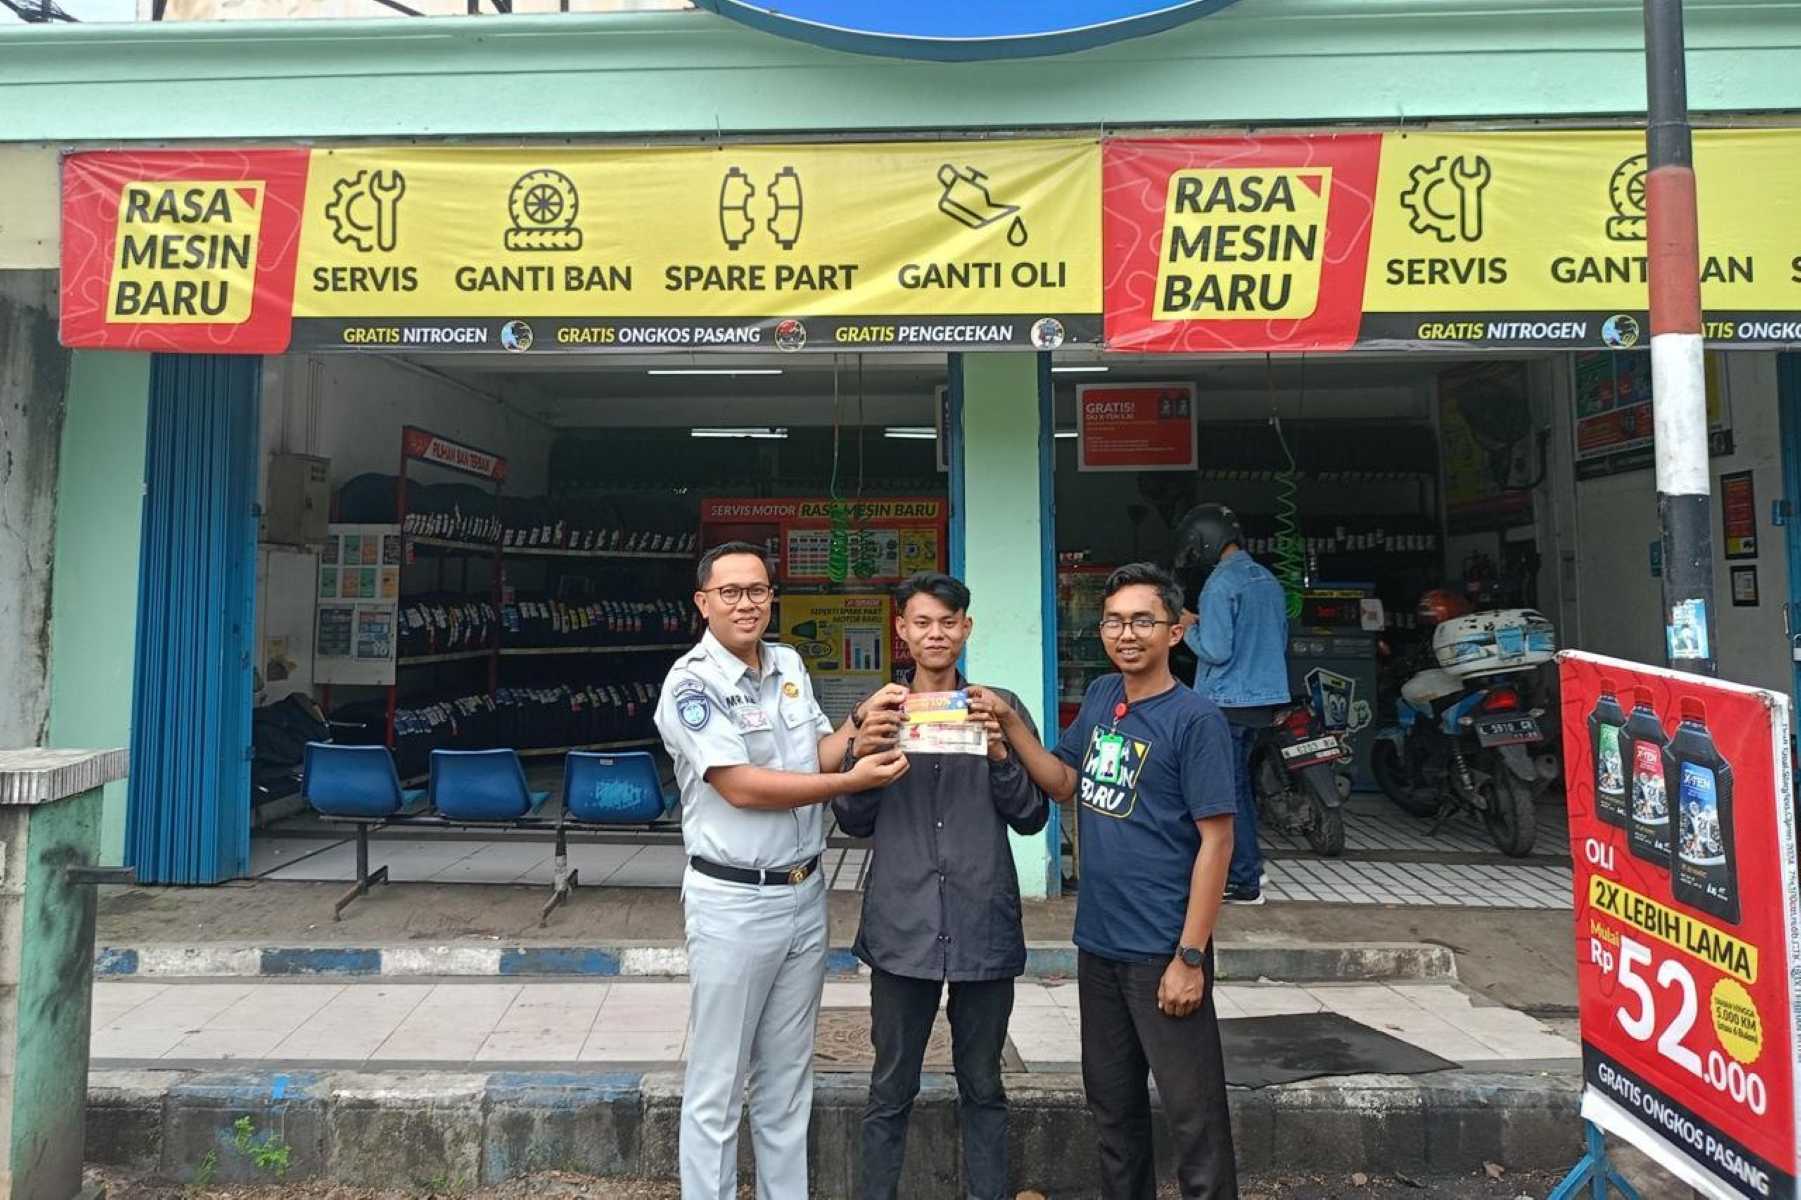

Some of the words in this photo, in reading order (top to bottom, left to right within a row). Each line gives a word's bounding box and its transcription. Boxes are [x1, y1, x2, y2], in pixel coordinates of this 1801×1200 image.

[126, 188, 232, 223] RASA
[1175, 176, 1295, 213] RASA
[121, 235, 250, 270] MESIN
[1169, 224, 1317, 263] MESIN
[313, 266, 418, 292] SERVIS
[455, 266, 554, 292] GANTI
[564, 266, 632, 291] BAN
[665, 265, 765, 291] SPARE
[776, 264, 858, 291] PART
[898, 263, 1001, 289] GANTI
[1011, 262, 1066, 288] OLI
[1387, 258, 1507, 285] SERVIS
[1551, 256, 1649, 284] GANT
[1699, 256, 1754, 283] AN
[115, 281, 228, 316] BARU
[1162, 274, 1292, 312] BARU
[343, 327, 400, 343] GRATIS
[403, 328, 487, 343] NITROGEN
[558, 328, 615, 343] GRATIS
[618, 327, 690, 343] ONGKOS
[694, 327, 760, 343] PASANG
[836, 327, 895, 343] GRATIS
[899, 326, 1013, 342] PENGECEKAN
[1418, 322, 1483, 339] GRATIS
[1487, 322, 1586, 339] NITROGEN
[711, 505, 750, 516] SERVIS
[751, 505, 795, 516] MOTOR
[801, 504, 838, 517] RAS
[895, 503, 936, 517] BARU
[1585, 838, 1614, 871] OLI
[1591, 919, 1619, 948] Mulai
[1595, 880, 1620, 915] 2X
[1624, 894, 1682, 944] LEBIH
[1687, 921, 1753, 979] LAMA
[1591, 937, 1613, 974] Rp
[1616, 935, 1767, 1116] 52.000
[1741, 1016, 1757, 1032] KM
[1599, 1063, 1641, 1106] GRATIS
[1643, 1093, 1703, 1144] ONGKOS
[1706, 1134, 1769, 1196] PASANG
